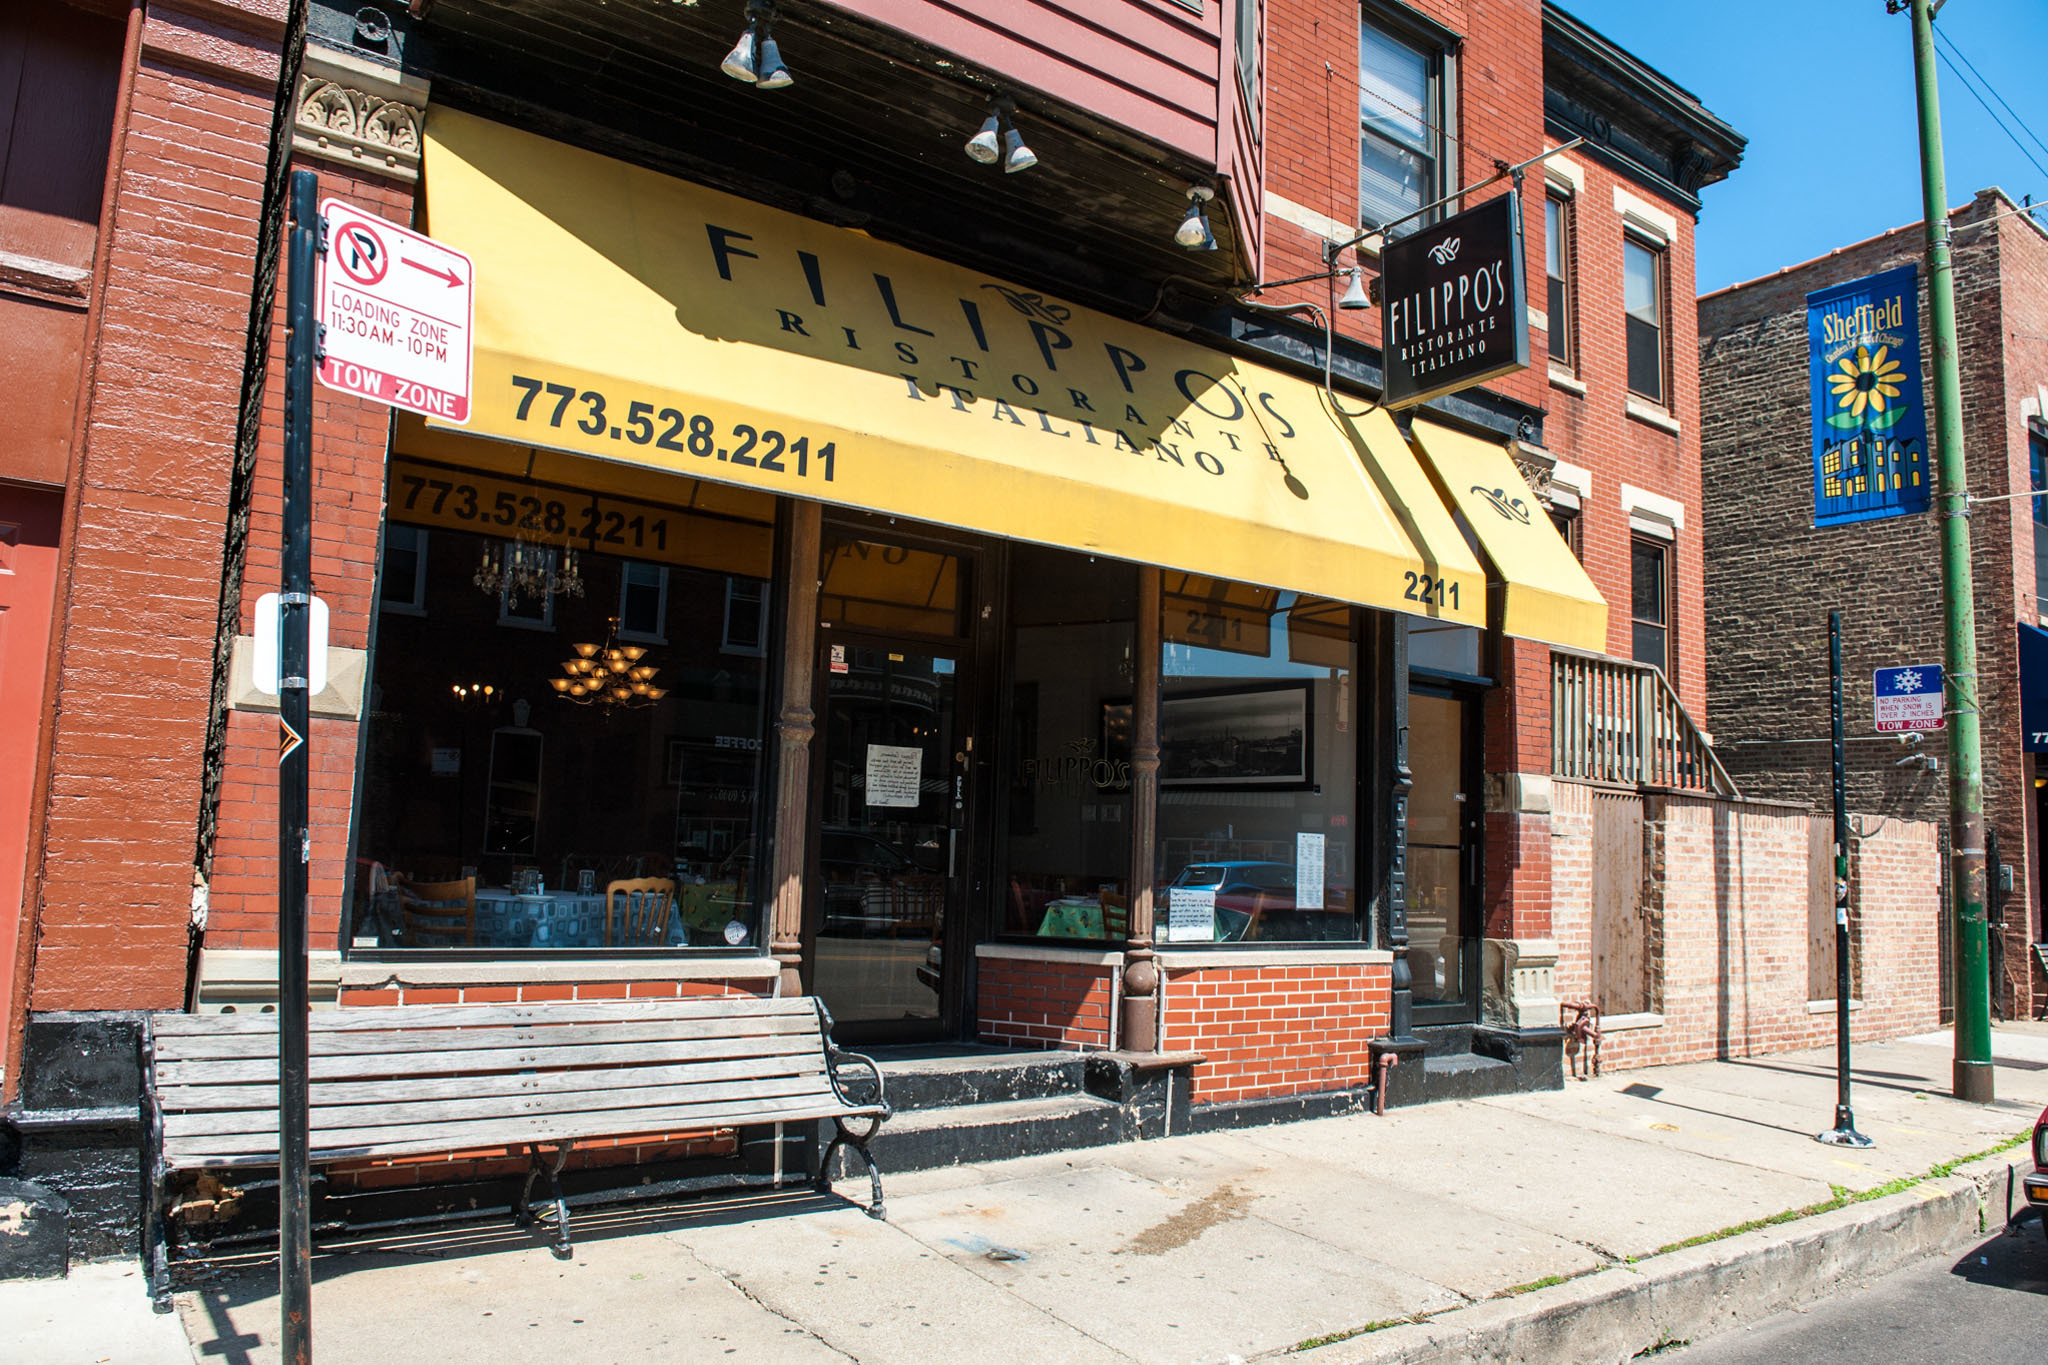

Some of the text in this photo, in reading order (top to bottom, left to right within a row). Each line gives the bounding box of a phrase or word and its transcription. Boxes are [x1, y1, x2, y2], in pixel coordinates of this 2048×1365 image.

[332, 291, 448, 344] LOADING ZONE
[1390, 260, 1504, 345] FILIPPO'S
[1823, 295, 1903, 344] Sheffield
[705, 223, 1295, 438] FILIPPO'S
[1402, 316, 1495, 360] RISTORANTE
[1411, 340, 1486, 376] ITALIANO
[329, 359, 456, 416] TOW ZONE
[776, 309, 1285, 464] RISTORANTE
[512, 375, 836, 482] 773.528.2211
[900, 373, 1224, 475] ITALIANO
[402, 475, 667, 550] 773.528.2211
[1404, 571, 1458, 610] 2211
[1881, 719, 1938, 730] TOW ZONE
[1023, 757, 1130, 790] FILIPPO'S
